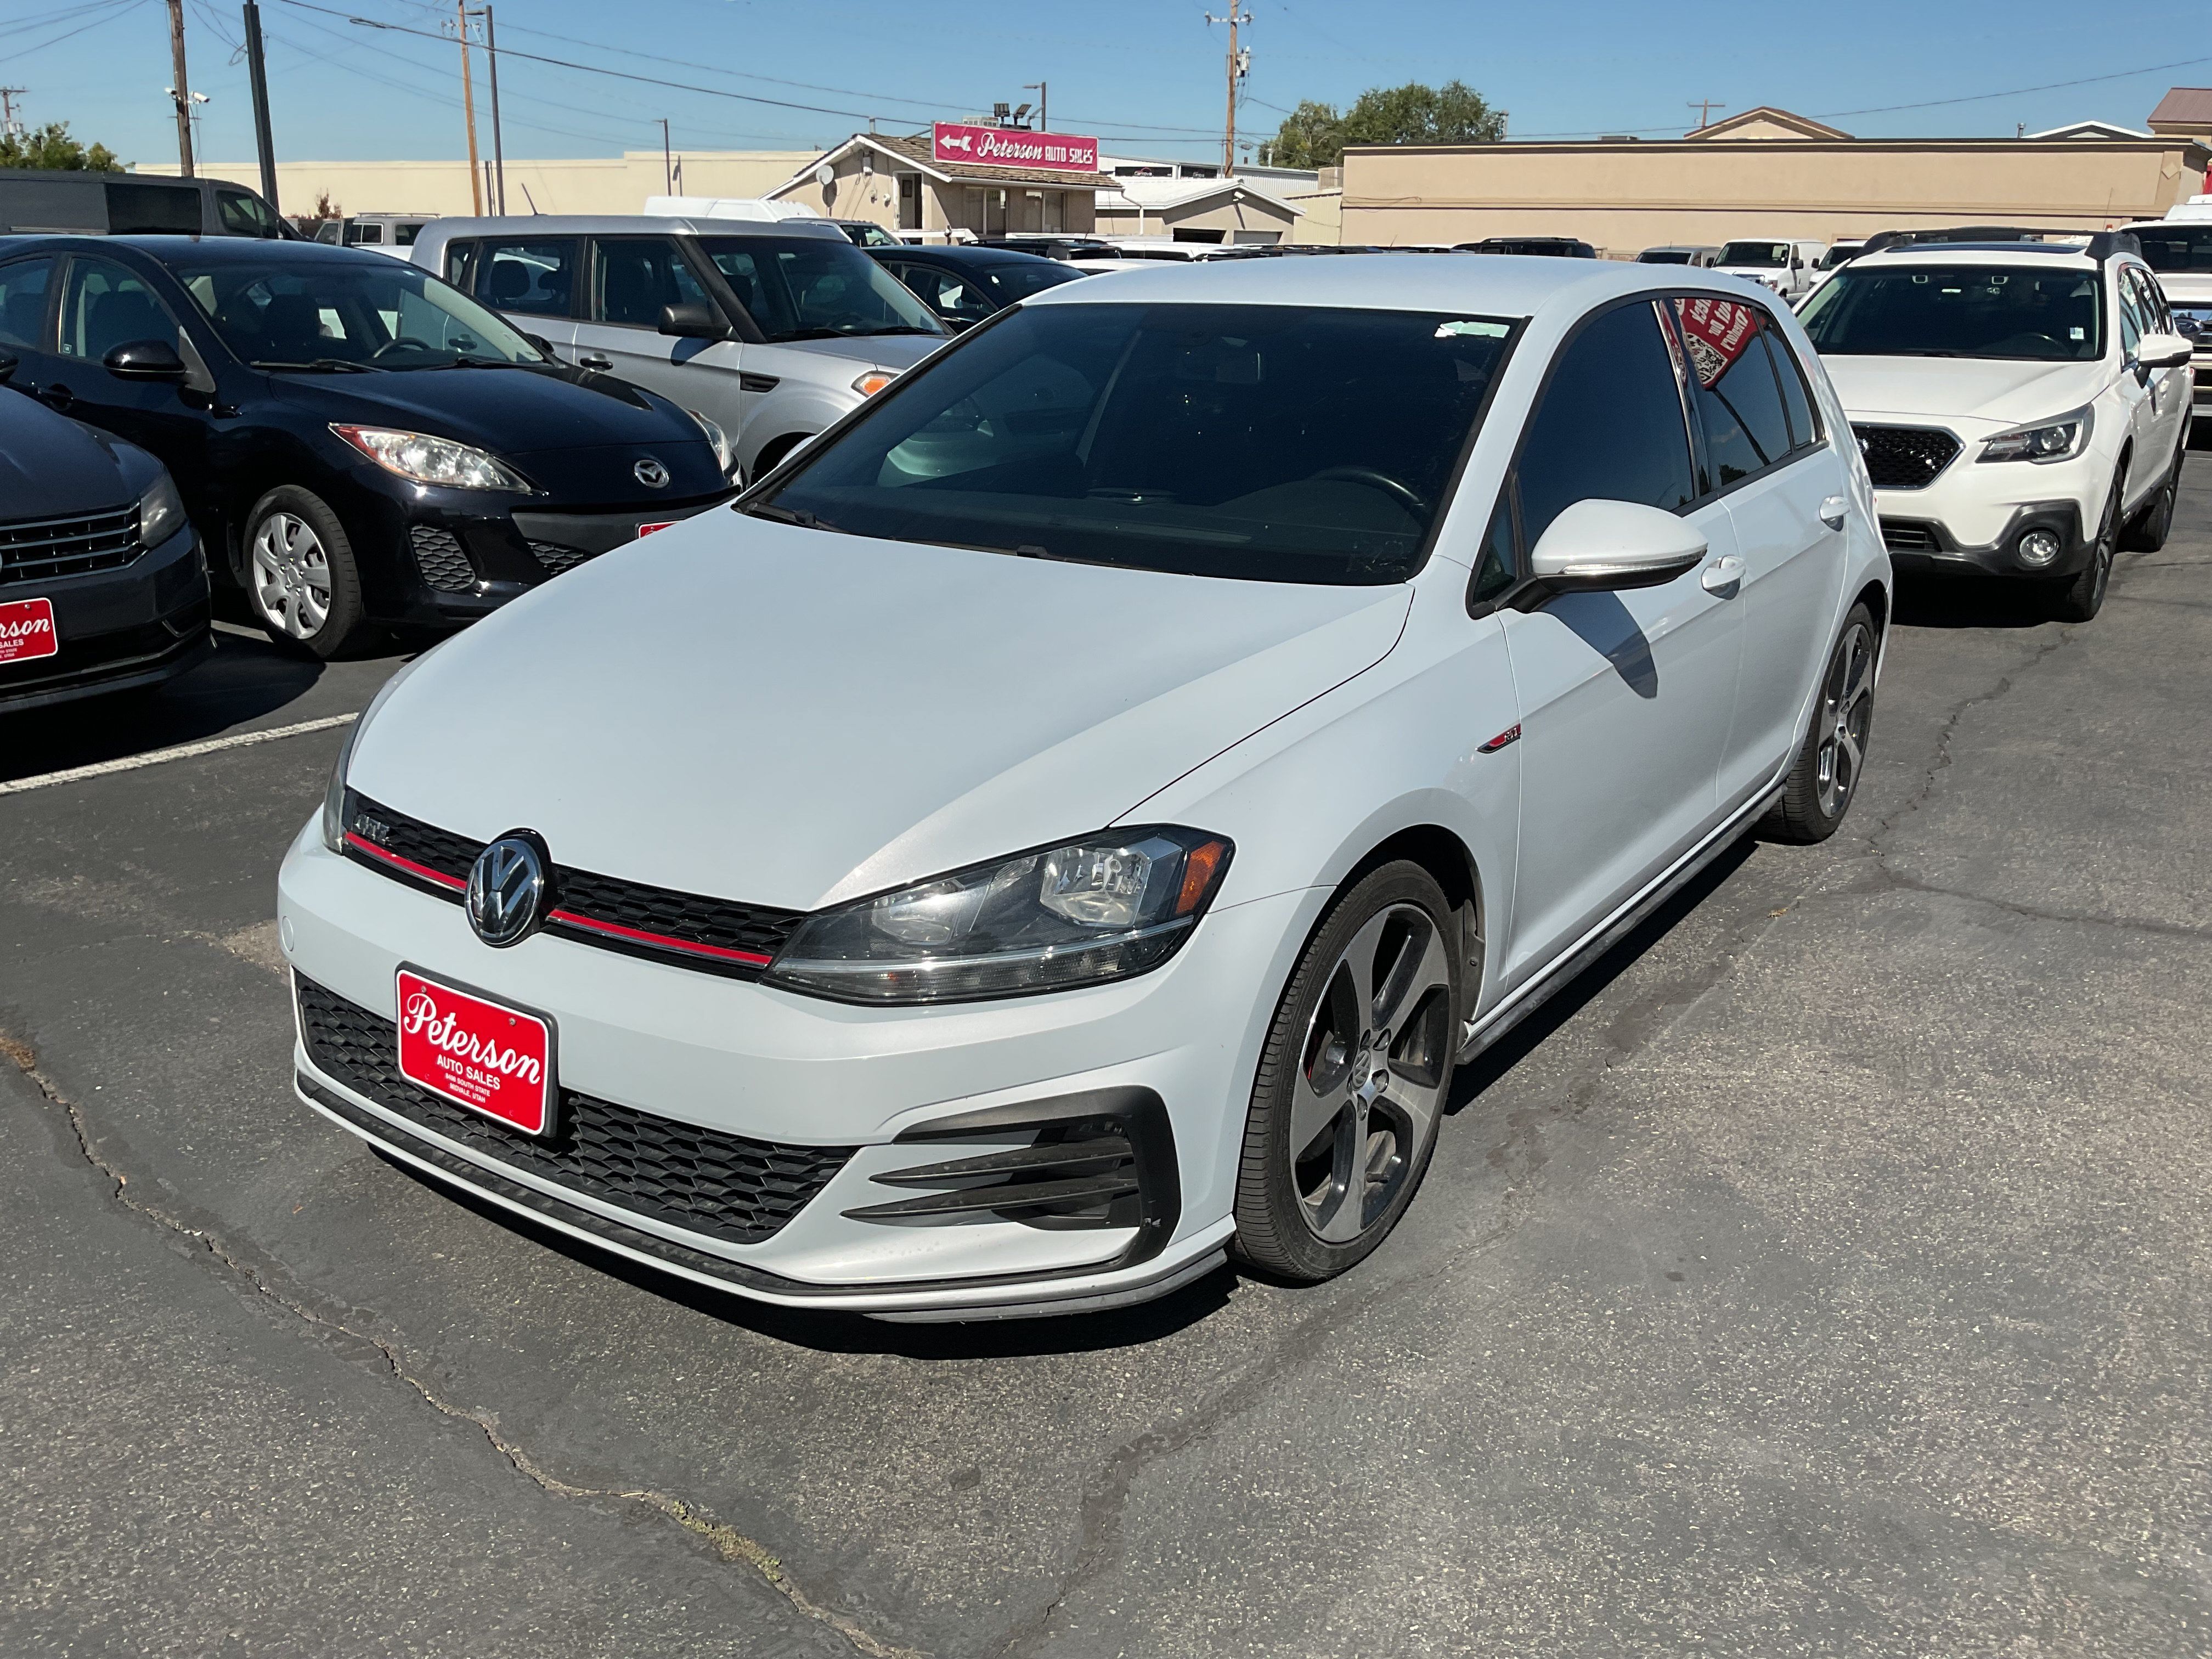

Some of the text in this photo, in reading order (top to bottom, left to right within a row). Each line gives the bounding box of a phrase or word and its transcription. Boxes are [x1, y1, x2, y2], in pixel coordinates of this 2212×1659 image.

[977, 132, 1093, 164] Peterson AUTO SALES
[354, 814, 390, 845] GTI
[404, 992, 540, 1084] Peterson
[437, 1054, 500, 1090] AUTO SALES
[457, 1077, 474, 1090] SOUTH
[475, 1085, 490, 1097] STATE
[472, 1092, 486, 1103] UTAH
